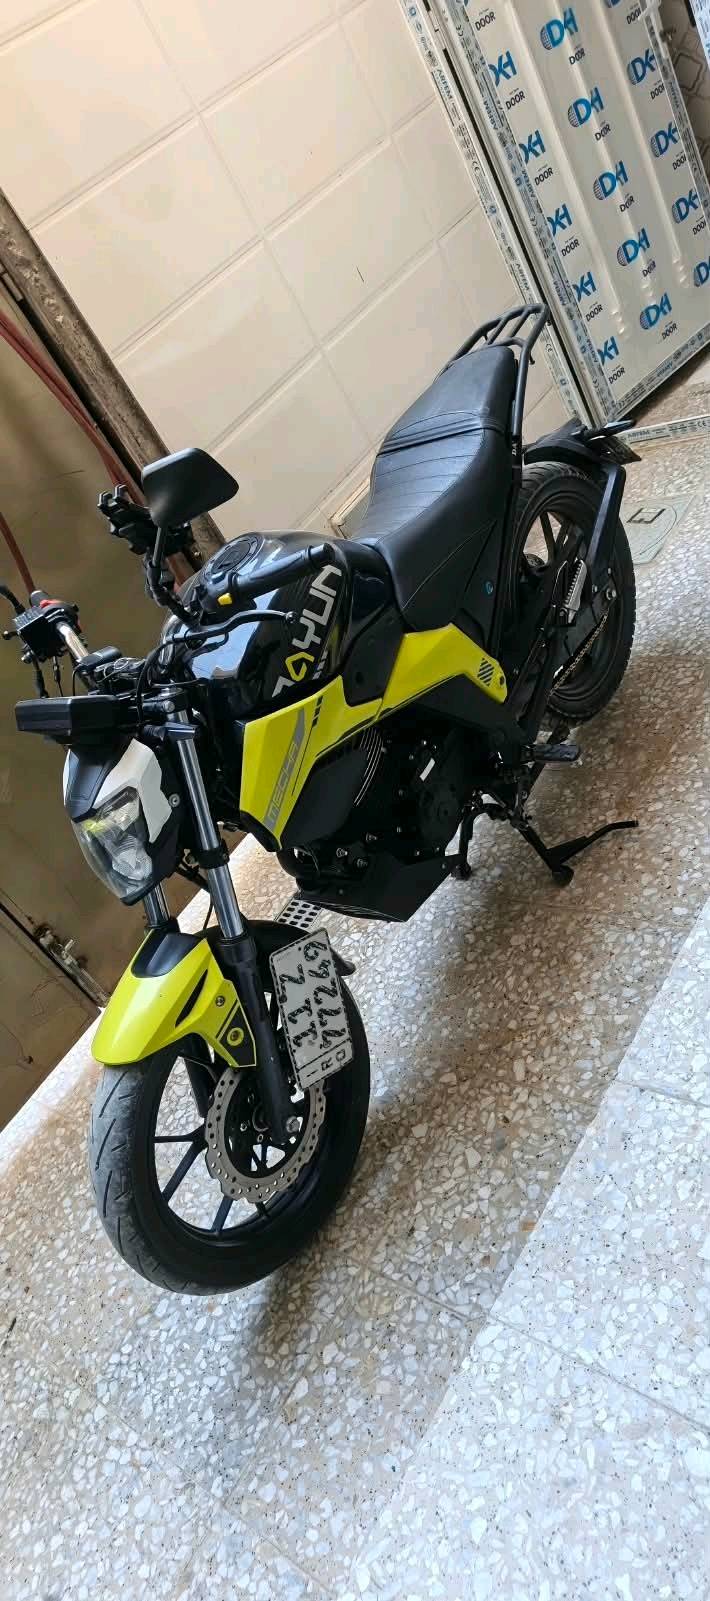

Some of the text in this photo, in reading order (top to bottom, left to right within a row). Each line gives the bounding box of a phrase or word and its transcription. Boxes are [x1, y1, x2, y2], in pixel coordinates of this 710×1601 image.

[475, 11, 496, 31] DOOR
[505, 90, 525, 110] DOOR
[534, 167, 553, 186] DOOR
[561, 239, 580, 257] DOOR
[585, 304, 603, 322] DOOR
[661, 323, 677, 340] DOOR
[608, 367, 625, 384] DOOR
